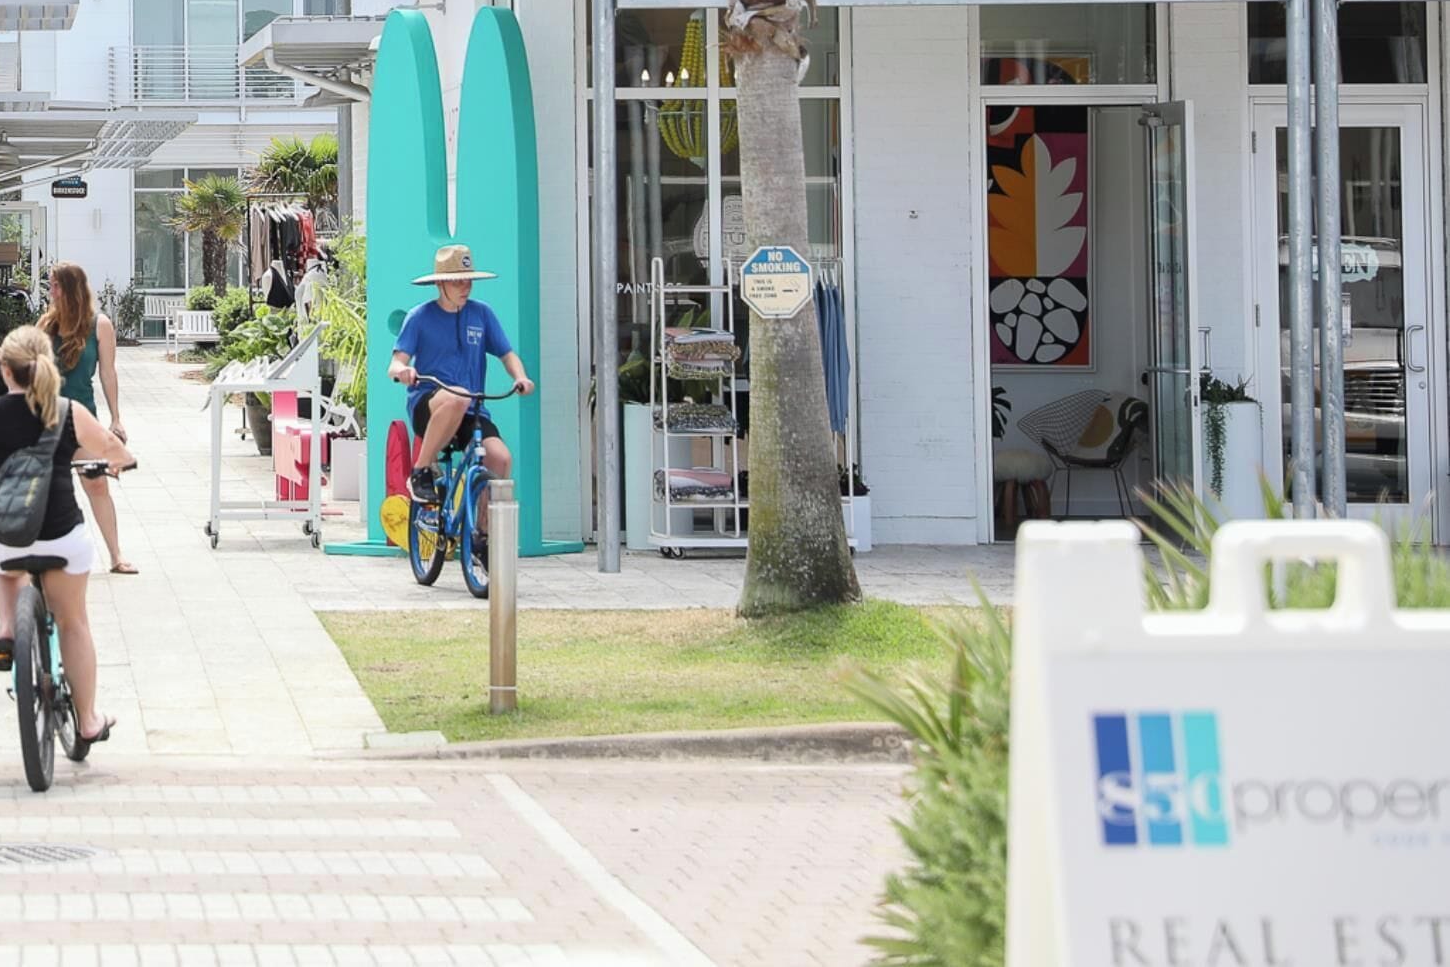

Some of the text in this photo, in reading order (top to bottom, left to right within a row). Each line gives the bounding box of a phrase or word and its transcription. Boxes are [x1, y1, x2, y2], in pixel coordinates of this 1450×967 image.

[767, 251, 783, 262] NO
[751, 262, 801, 273] SMOKING
[1108, 915, 1292, 967] REAL
